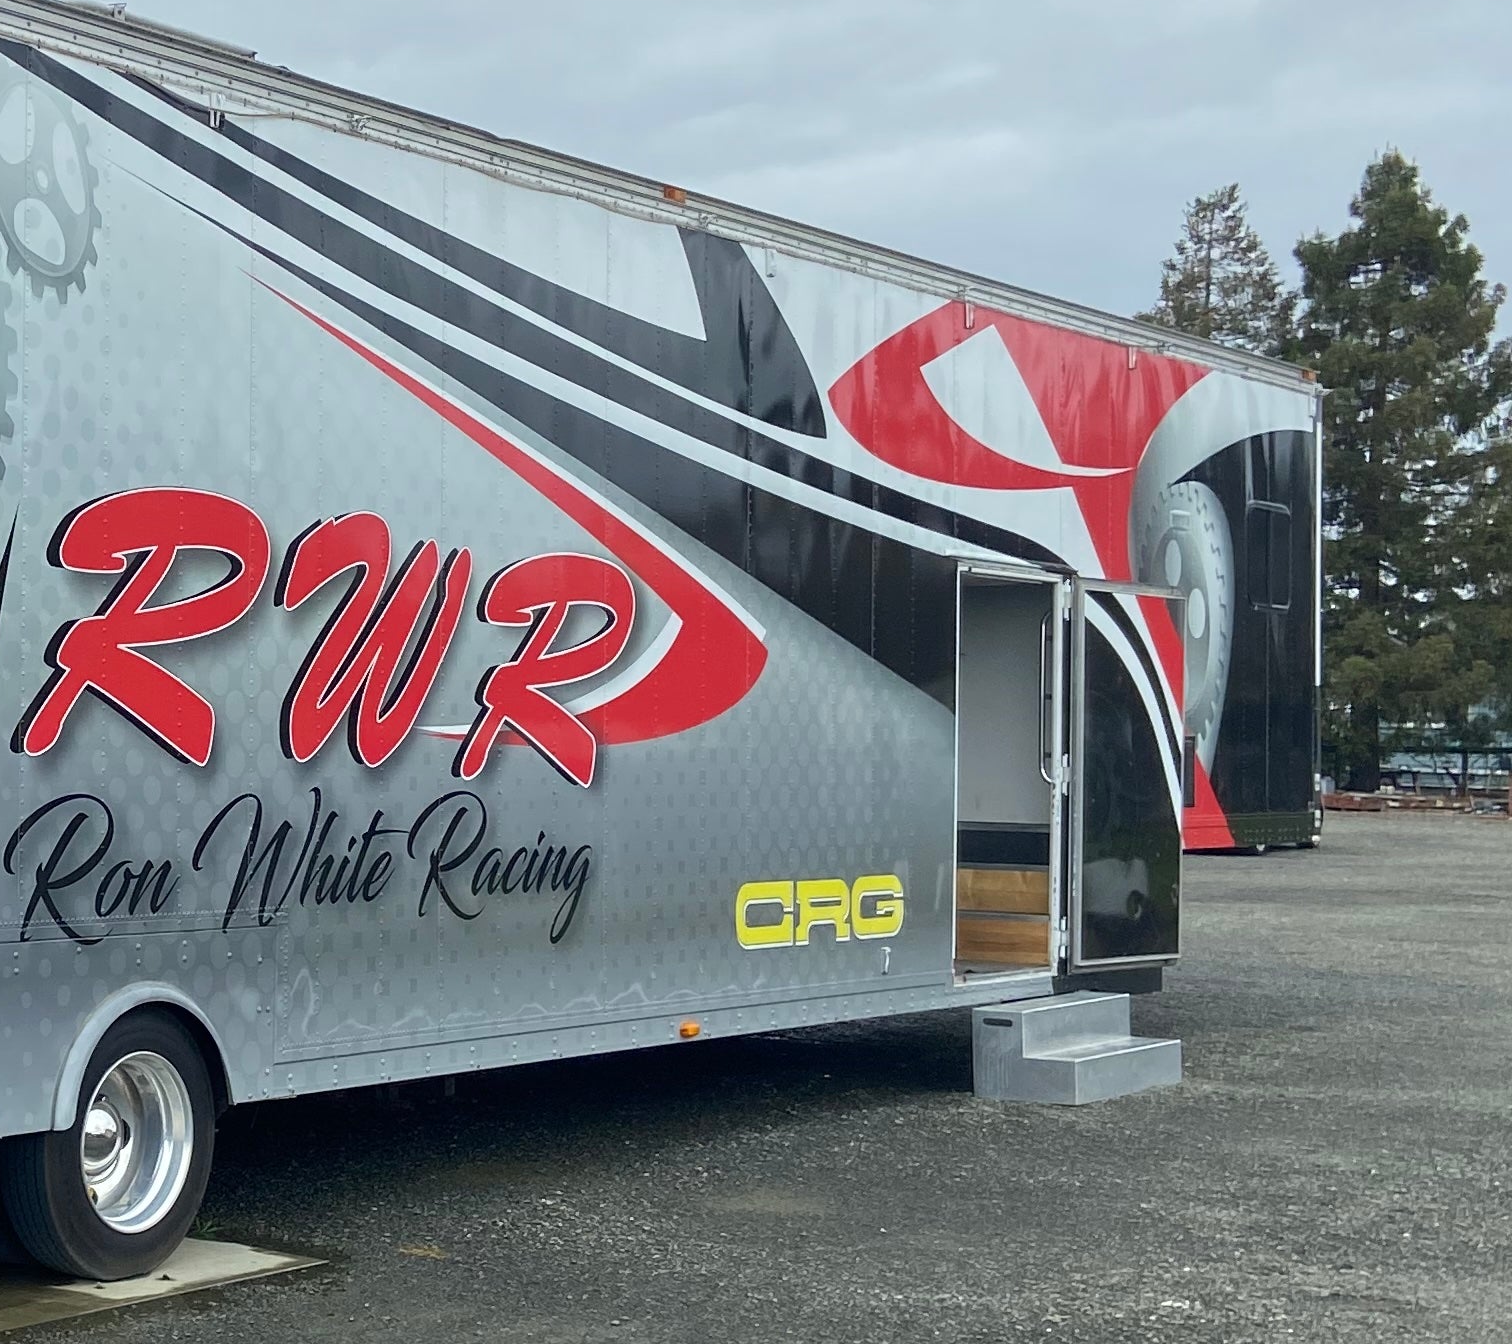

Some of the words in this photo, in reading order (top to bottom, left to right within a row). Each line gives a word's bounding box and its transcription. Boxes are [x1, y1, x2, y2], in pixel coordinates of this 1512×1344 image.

[10, 486, 636, 788] RWR
[3, 793, 178, 945] Ron
[192, 786, 408, 932] White
[408, 790, 593, 945] Racing
[735, 874, 905, 950] CRG
